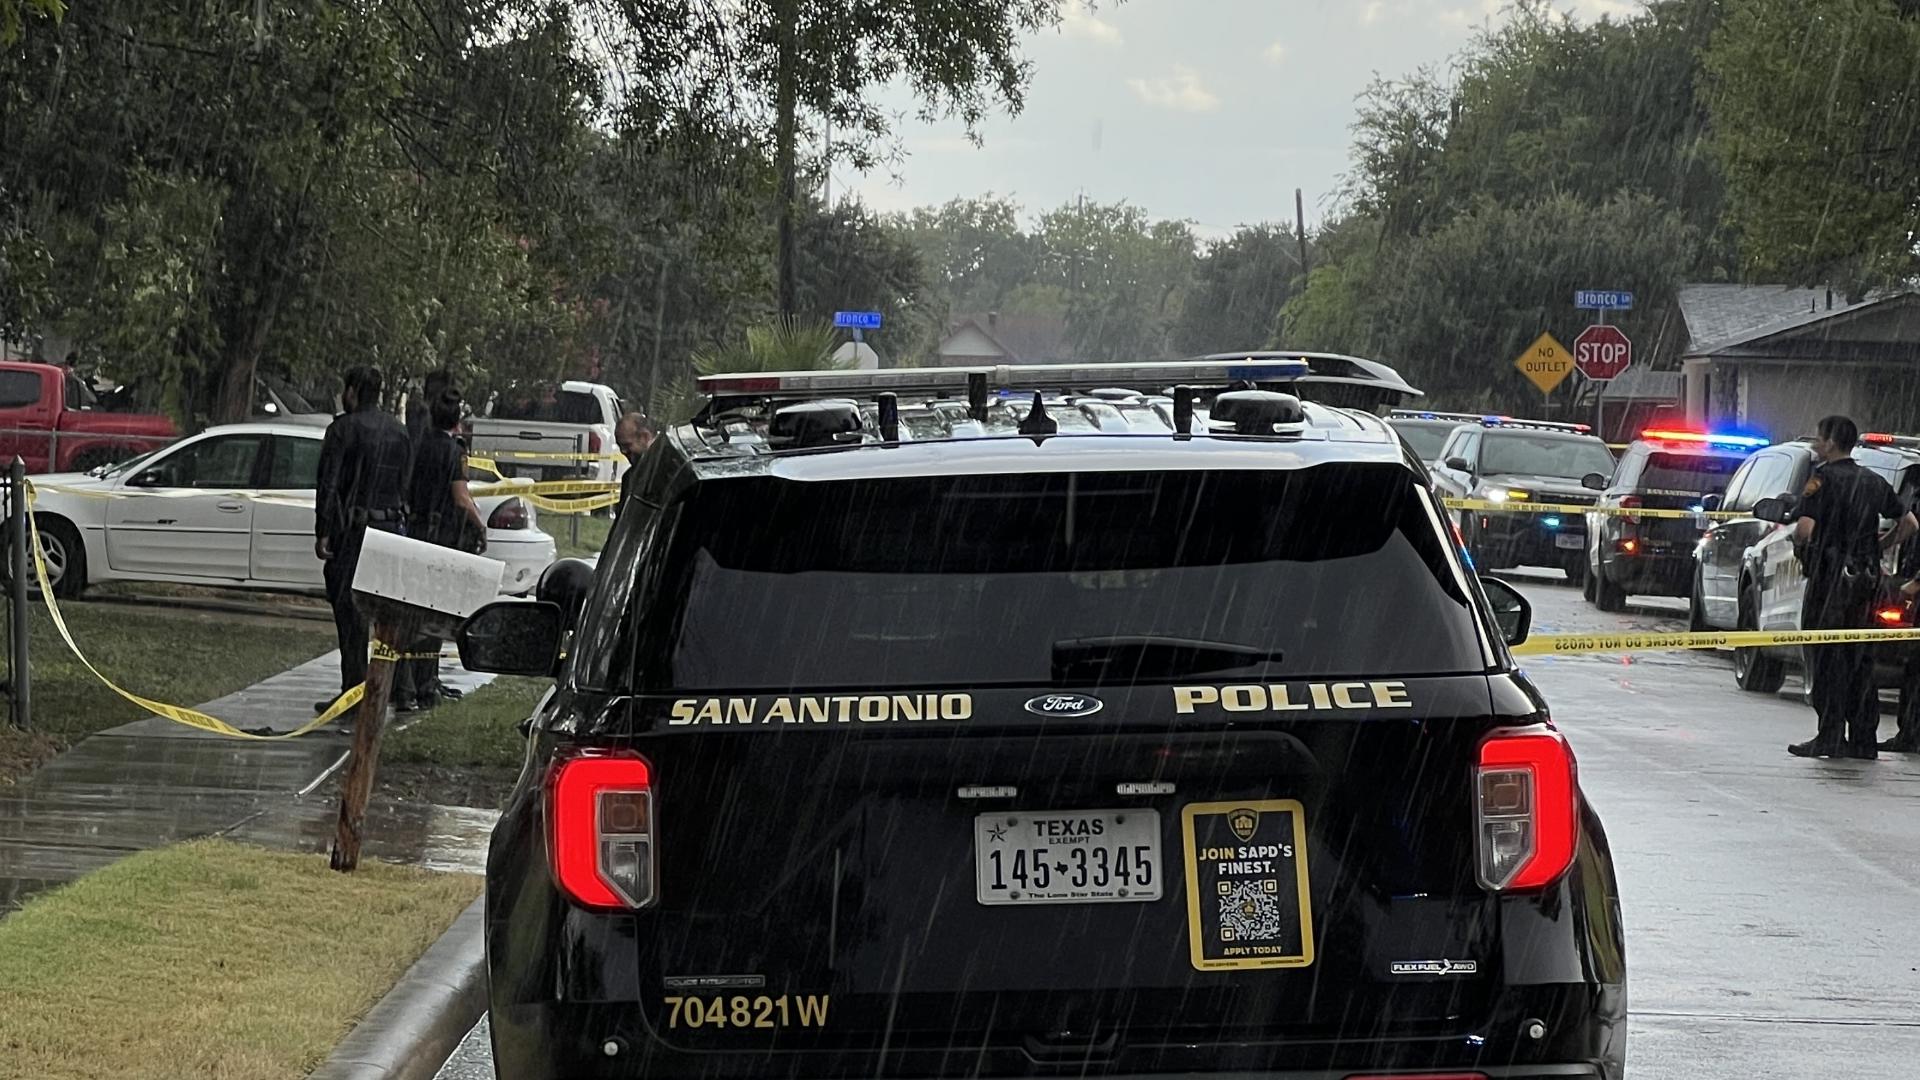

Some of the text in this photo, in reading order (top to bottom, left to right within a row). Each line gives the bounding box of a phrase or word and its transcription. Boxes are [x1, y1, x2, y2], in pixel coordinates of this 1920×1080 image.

[1578, 291, 1617, 305] Bronco
[1538, 347, 1554, 358] NO
[1578, 342, 1627, 364] STOP
[1526, 361, 1568, 373] OUTLET
[1043, 695, 1084, 711] Ford
[1172, 681, 1413, 714] POLICE
[669, 693, 972, 725] SAN ANTONIO
[1033, 819, 1104, 837] TEXAS
[1049, 836, 1090, 845] EXEMPT
[1199, 843, 1293, 861] JOIN SAPD'S
[990, 846, 1152, 890] 145 3345
[1218, 861, 1276, 875] FINEST.
[1223, 946, 1282, 956] APPLY TODAY
[664, 995, 830, 1029] 704821W
